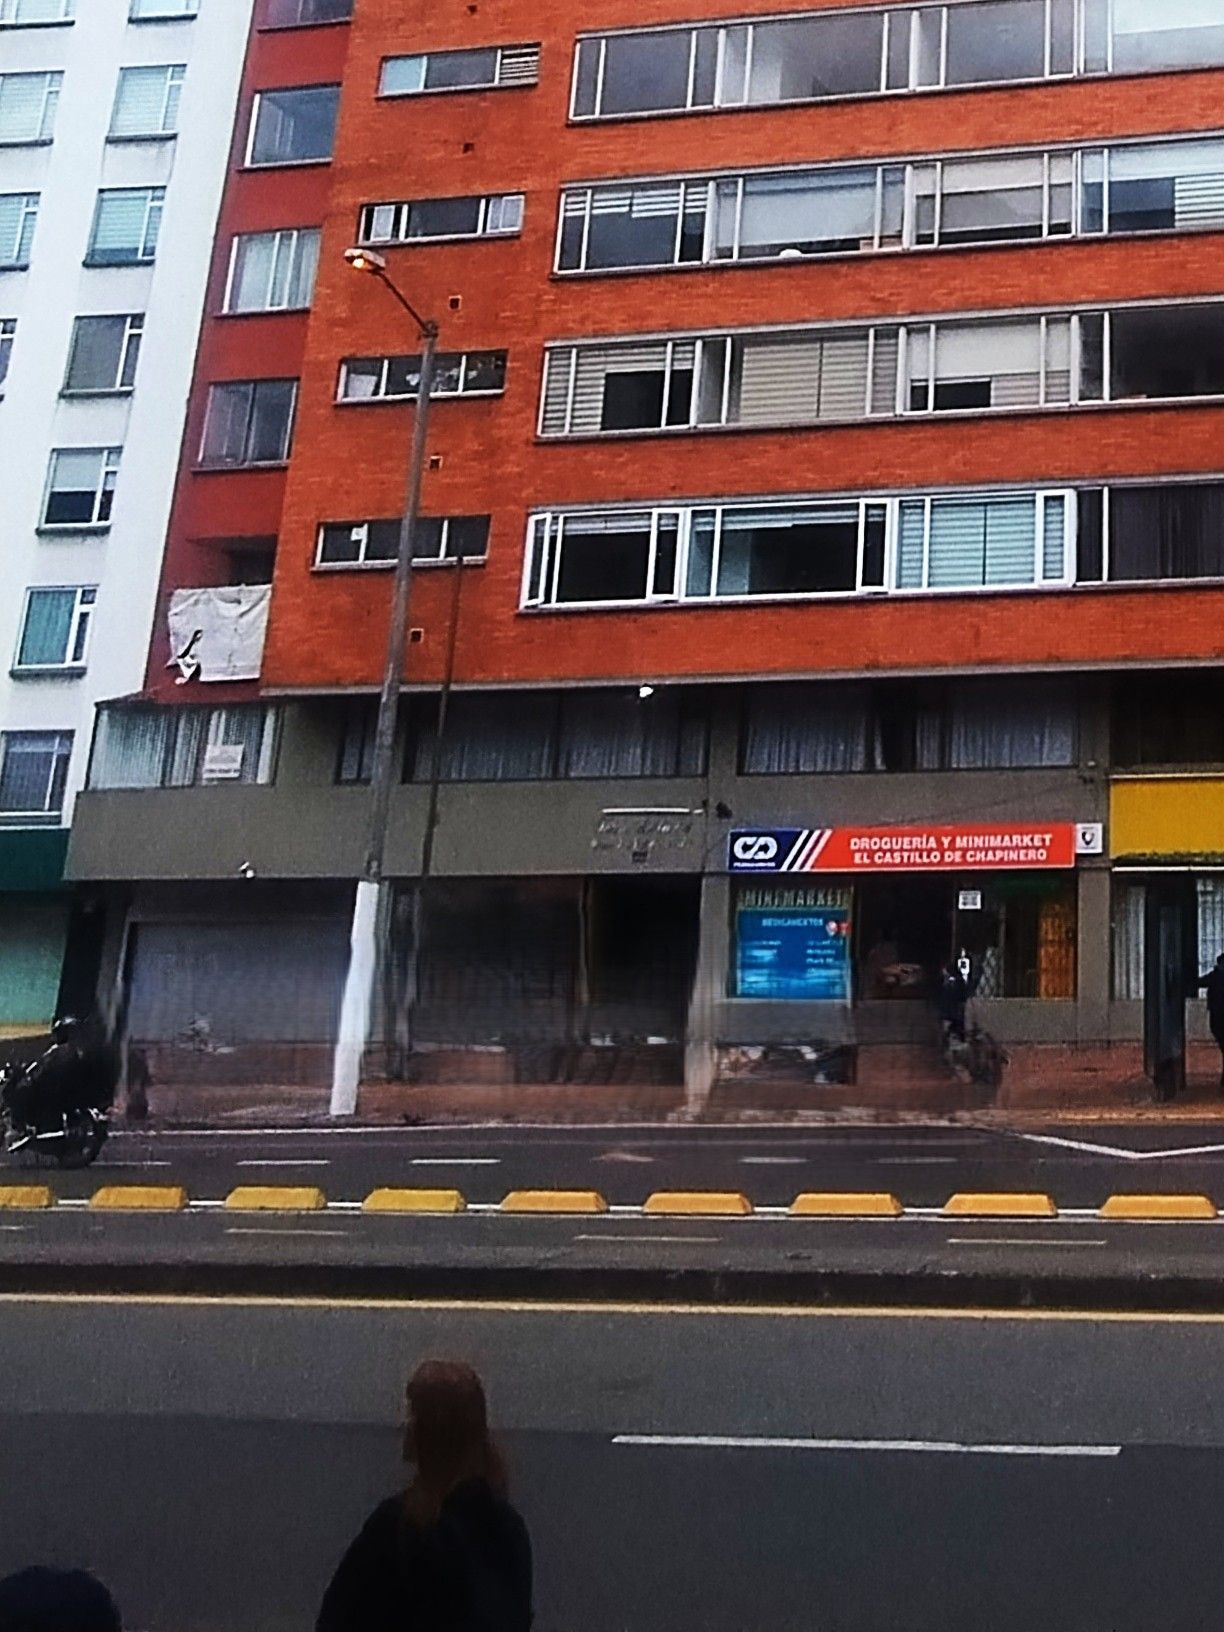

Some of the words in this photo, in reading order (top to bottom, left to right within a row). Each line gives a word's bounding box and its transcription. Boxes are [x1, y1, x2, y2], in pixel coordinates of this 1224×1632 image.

[850, 834, 937, 850] DROGUERÍA
[941, 836, 952, 849] Y
[955, 834, 1053, 849] MINIMARKET
[854, 852, 871, 864] EL
[874, 850, 941, 864] CASTILLO
[944, 850, 962, 862] DE
[966, 849, 1047, 862] CHAPINERO
